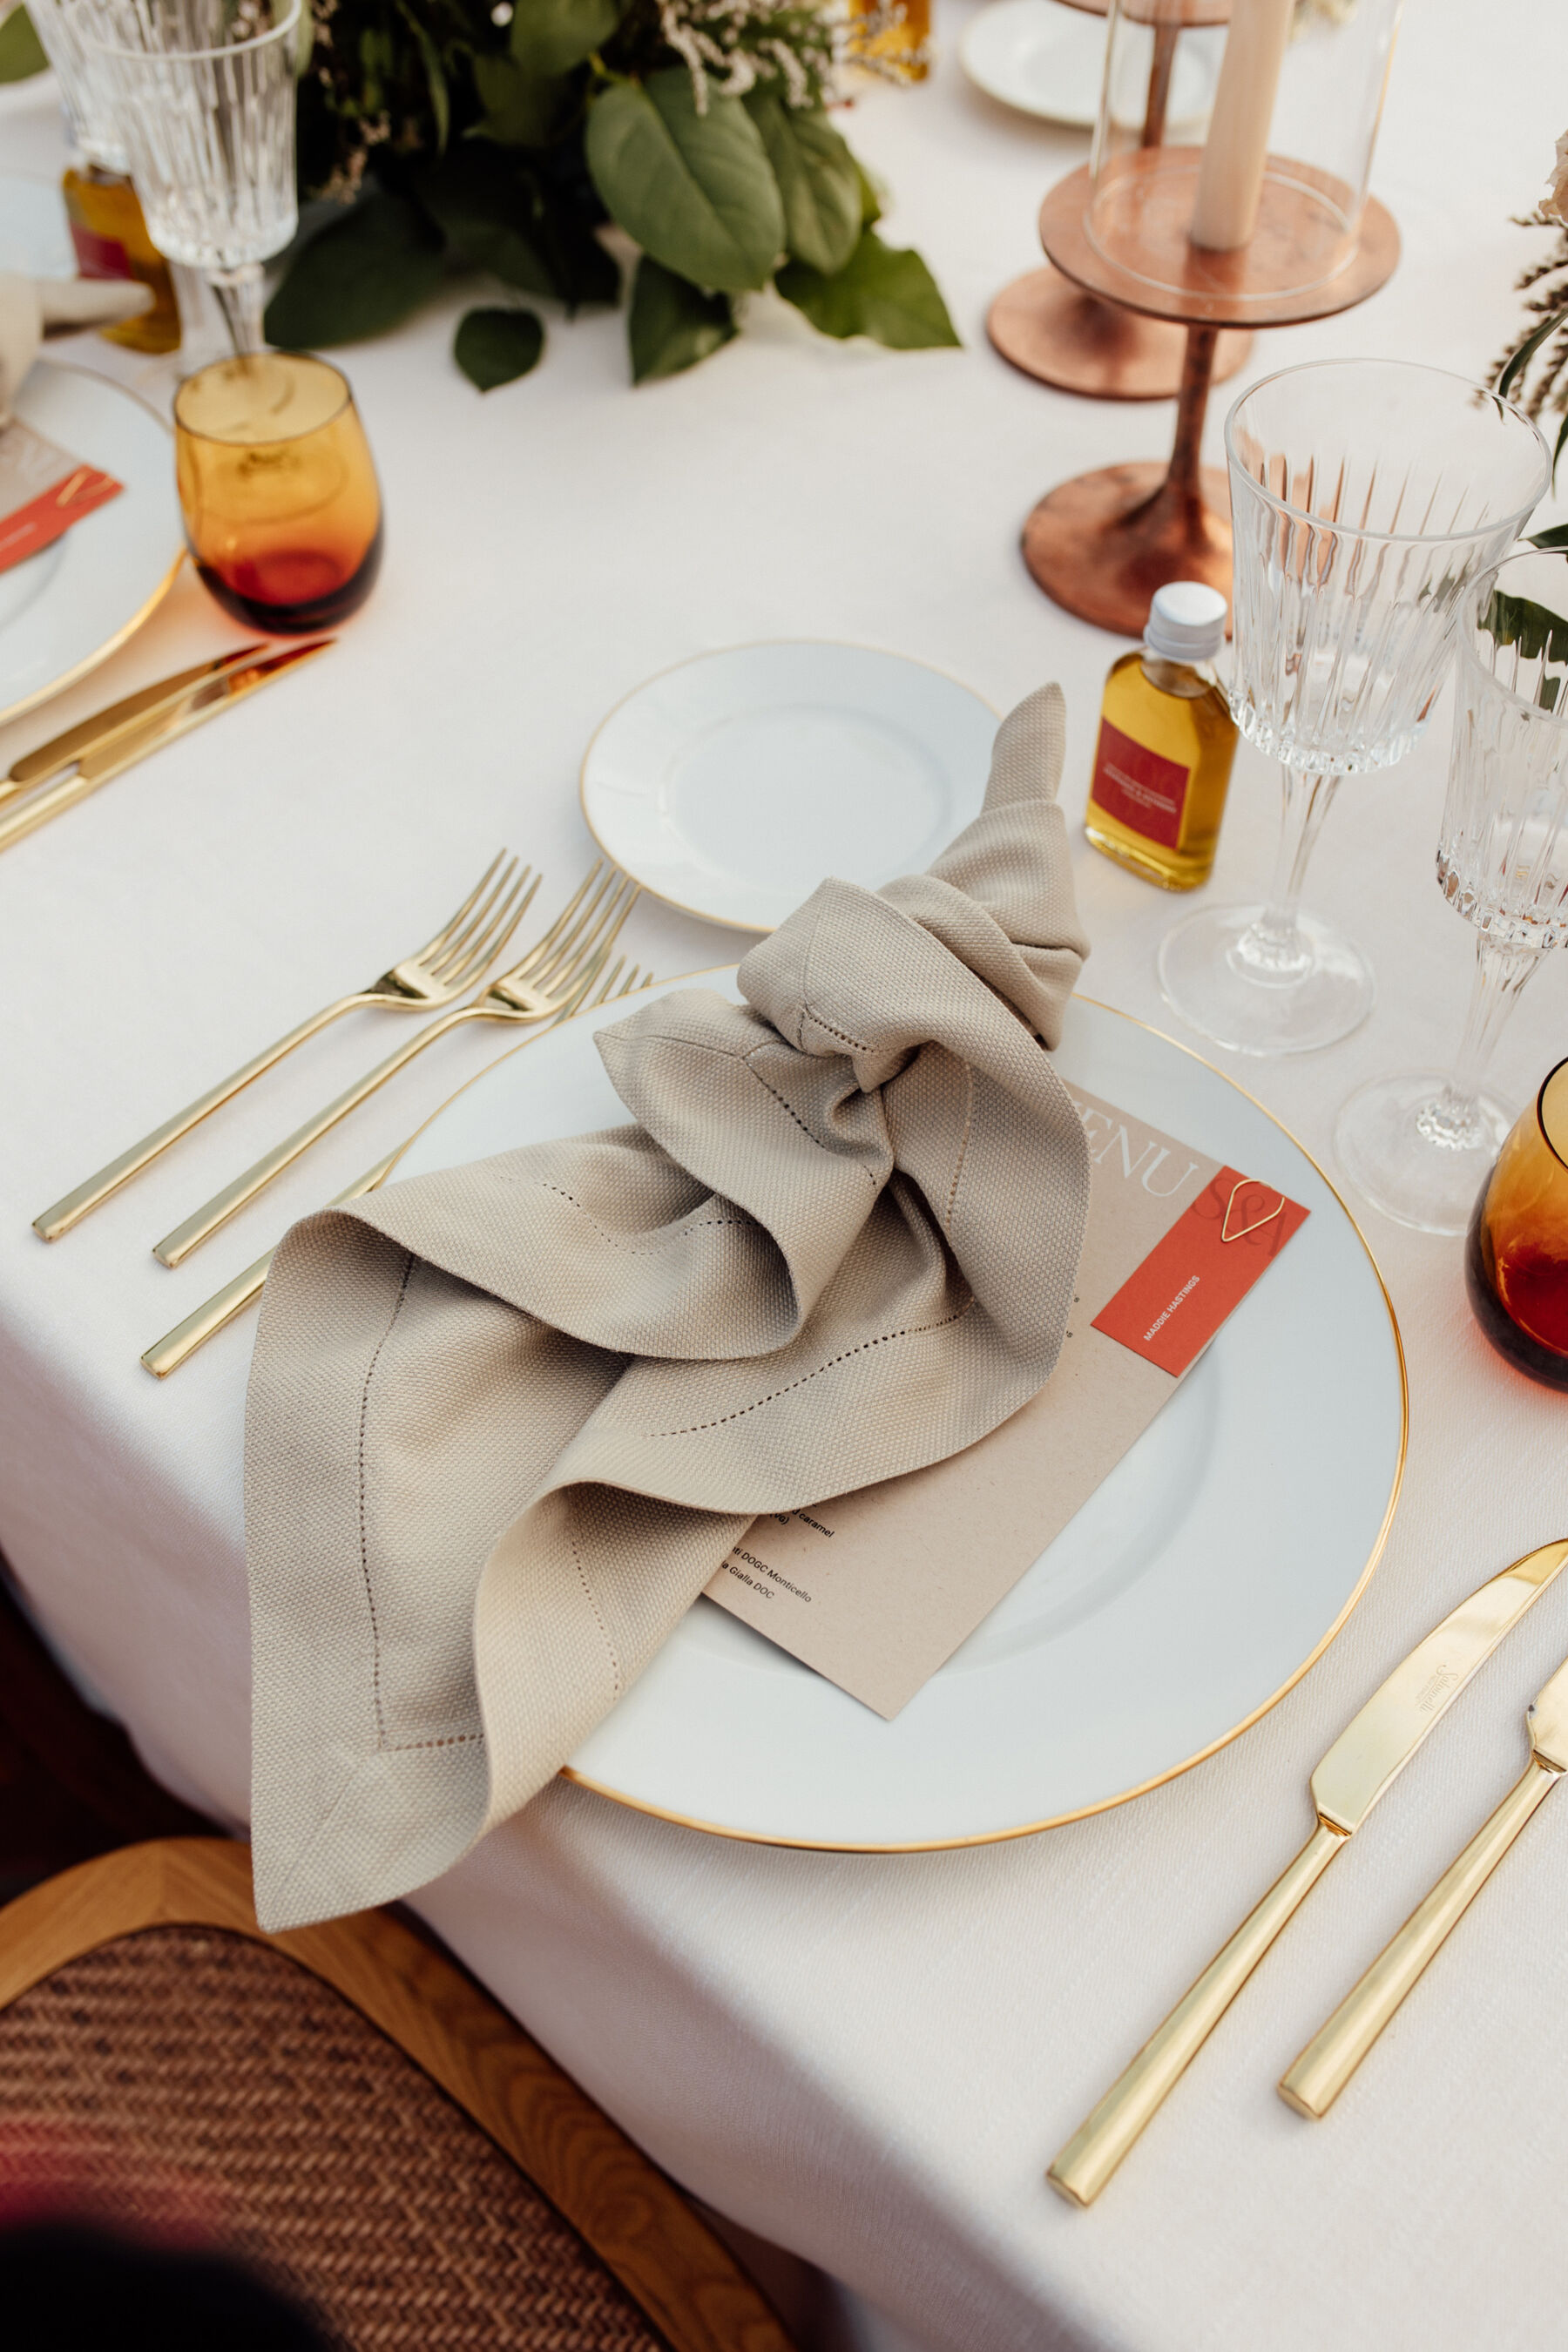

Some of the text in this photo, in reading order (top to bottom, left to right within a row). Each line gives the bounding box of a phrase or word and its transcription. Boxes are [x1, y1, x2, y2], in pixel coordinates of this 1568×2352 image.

[1073, 1101, 1200, 1198] ENU
[1143, 1274, 1200, 1341] MADDIE HASTINGS
[799, 1513, 835, 1538] caramel
[729, 1566, 754, 1586] Gialla
[753, 1582, 774, 1599] DOC
[741, 1551, 768, 1573] DOGC
[767, 1569, 812, 1603] Monticello
